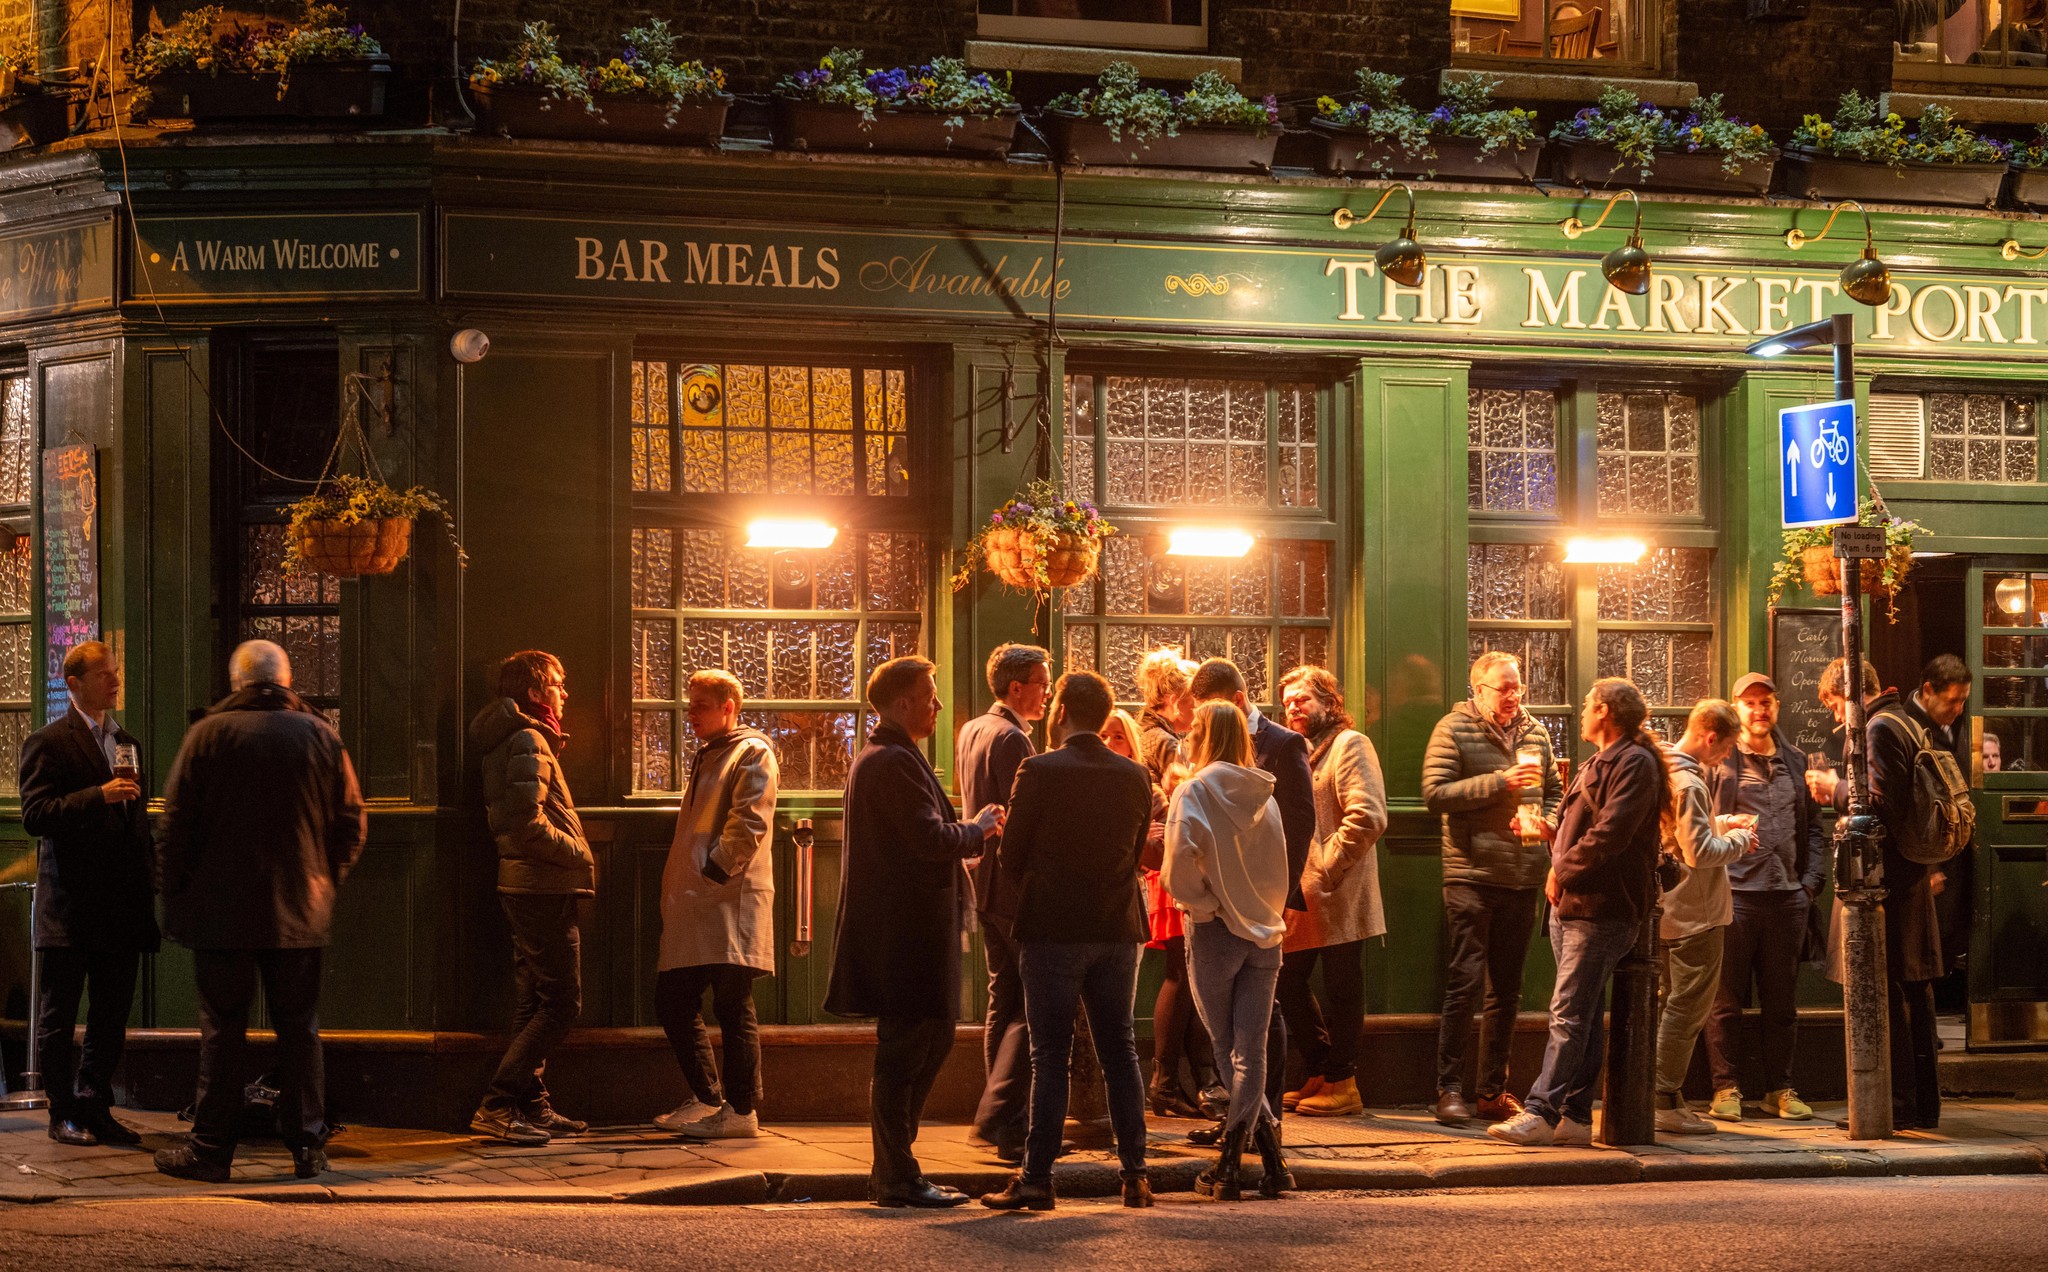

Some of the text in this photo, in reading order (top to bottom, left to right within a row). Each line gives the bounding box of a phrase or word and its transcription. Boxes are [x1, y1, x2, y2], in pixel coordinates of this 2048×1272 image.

[171, 238, 380, 272] A WARM WELCOME
[574, 236, 1073, 301] BAR MEALS Available
[1324, 257, 1483, 325] THE
[1520, 267, 1841, 336] MARKET
[1841, 532, 1881, 541] No loading
[1797, 627, 1828, 646] Early
[1789, 699, 1834, 718] Monday
[1807, 718, 1820, 728] to
[1795, 729, 1828, 748] Friday
